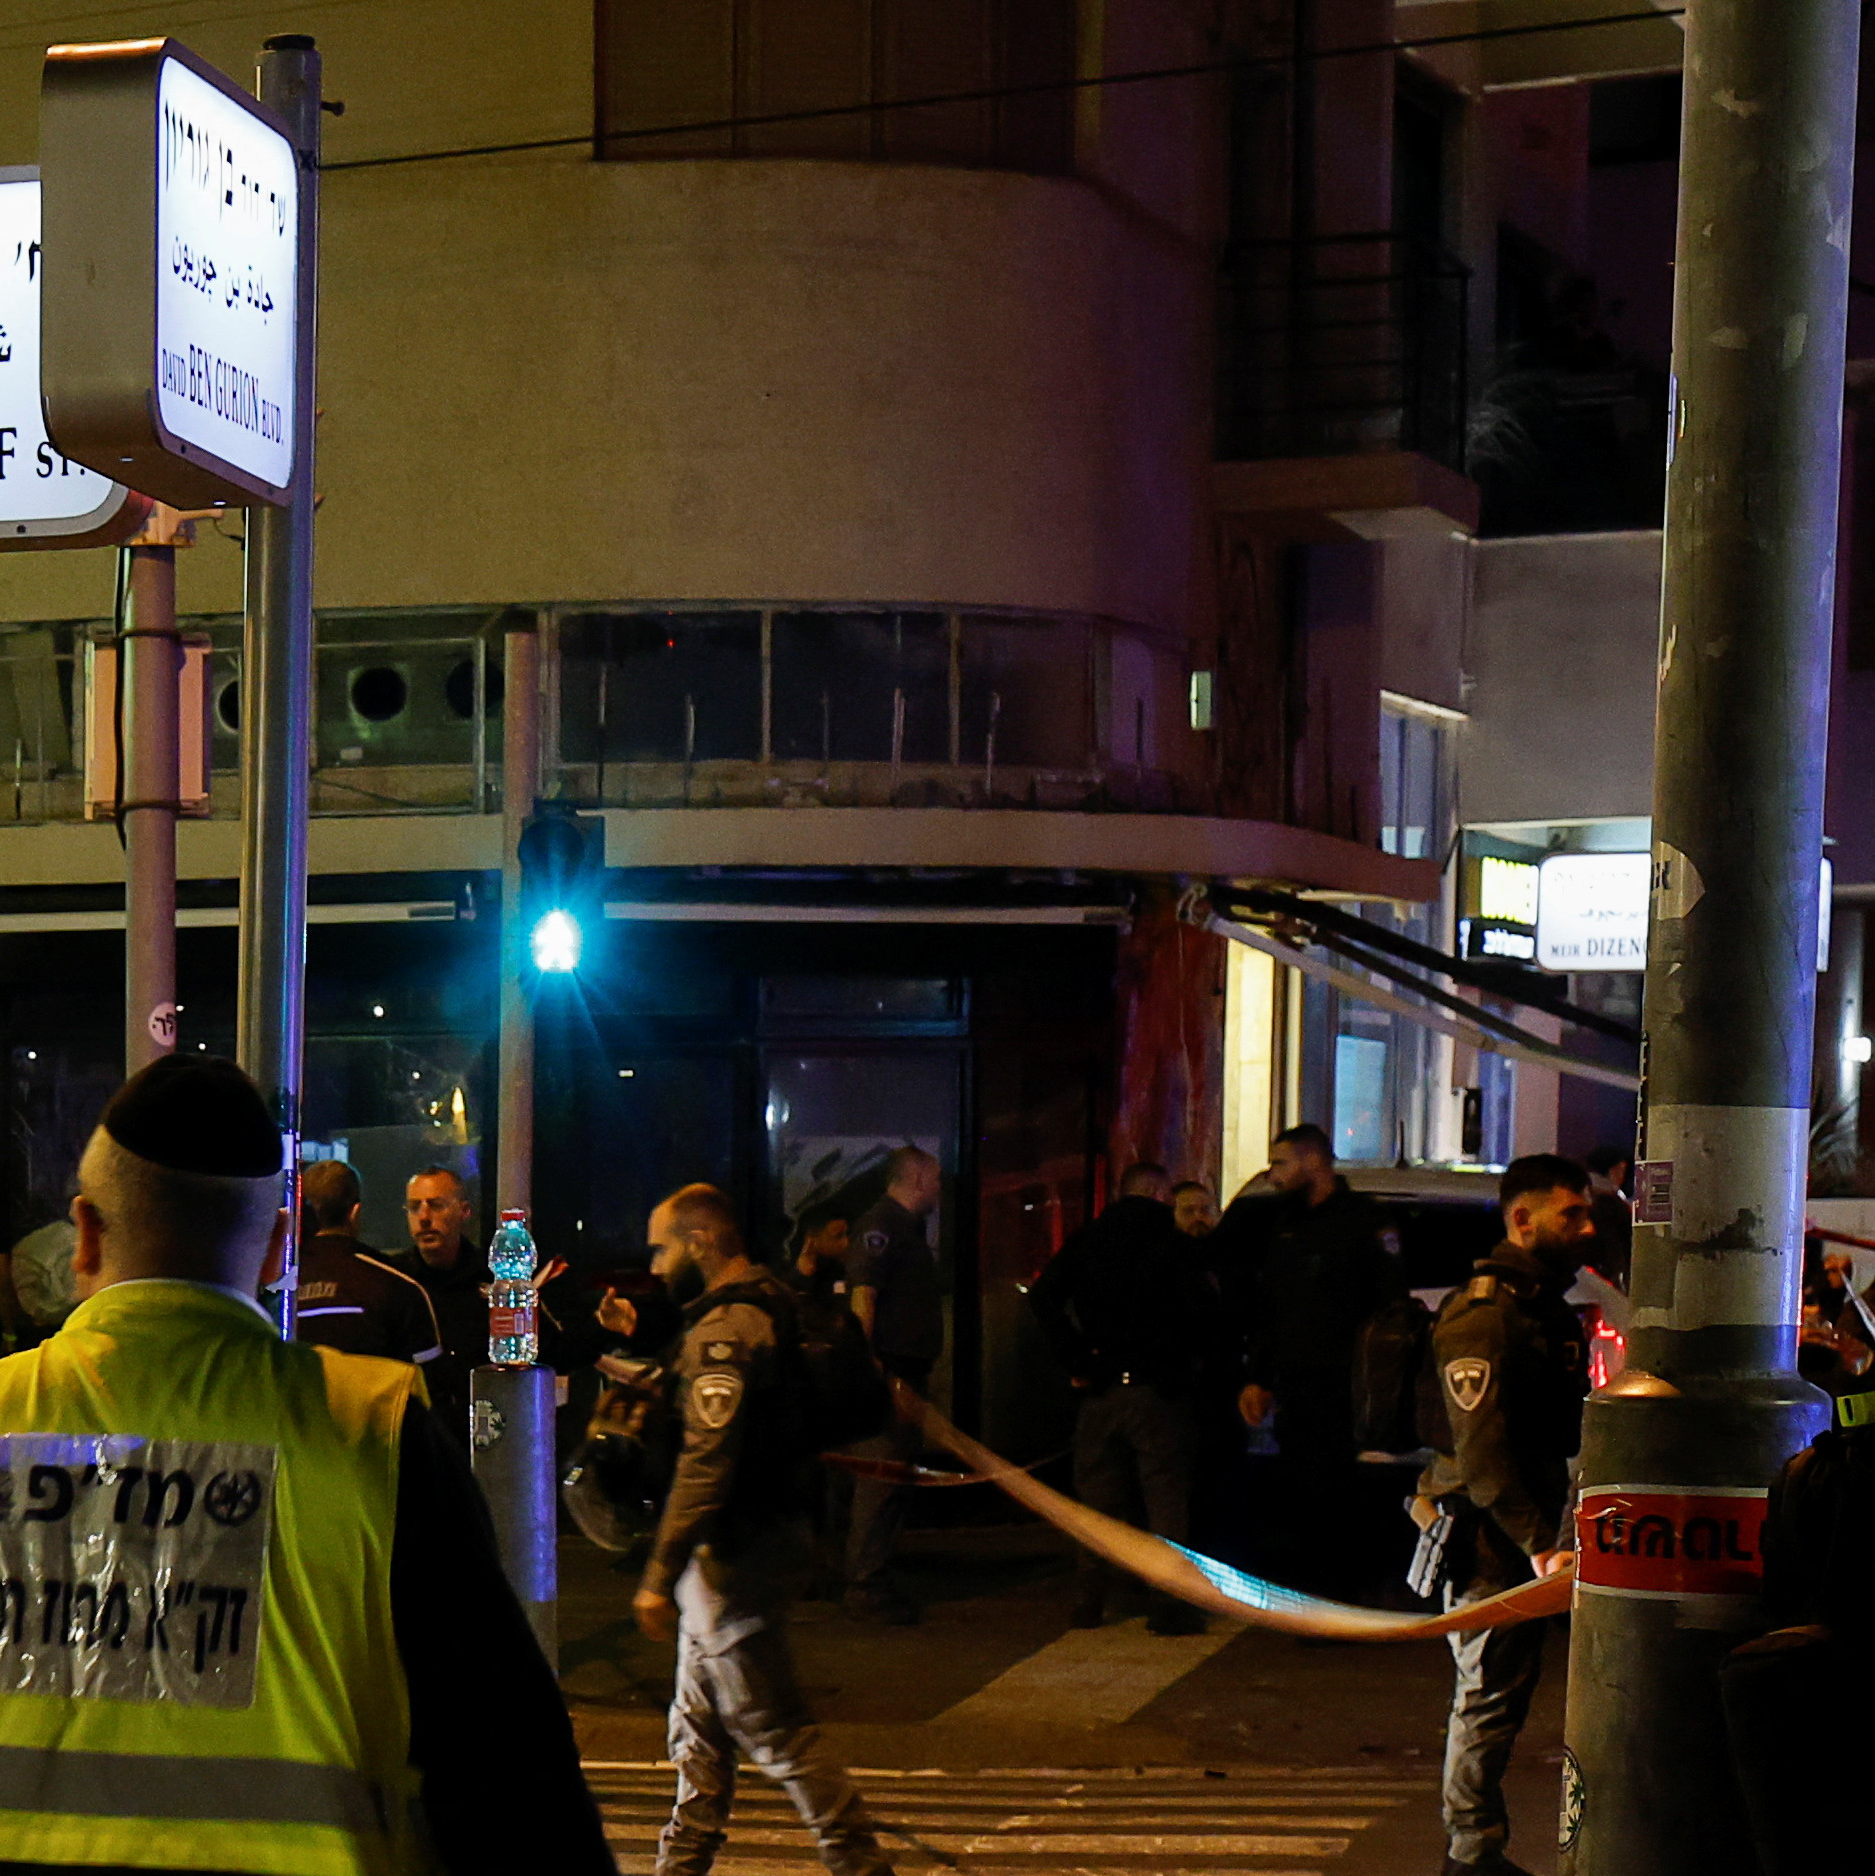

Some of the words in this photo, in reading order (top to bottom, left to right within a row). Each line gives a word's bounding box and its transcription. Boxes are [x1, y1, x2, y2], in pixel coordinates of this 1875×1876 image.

[164, 98, 210, 193] גוריון
[219, 138, 233, 224] בן
[162, 347, 185, 398] DAVID
[189, 343, 212, 412] BEN
[215, 356, 259, 436] GURION
[1587, 937, 1647, 957] DIZEN
[1595, 1514, 1768, 1562] משטר
